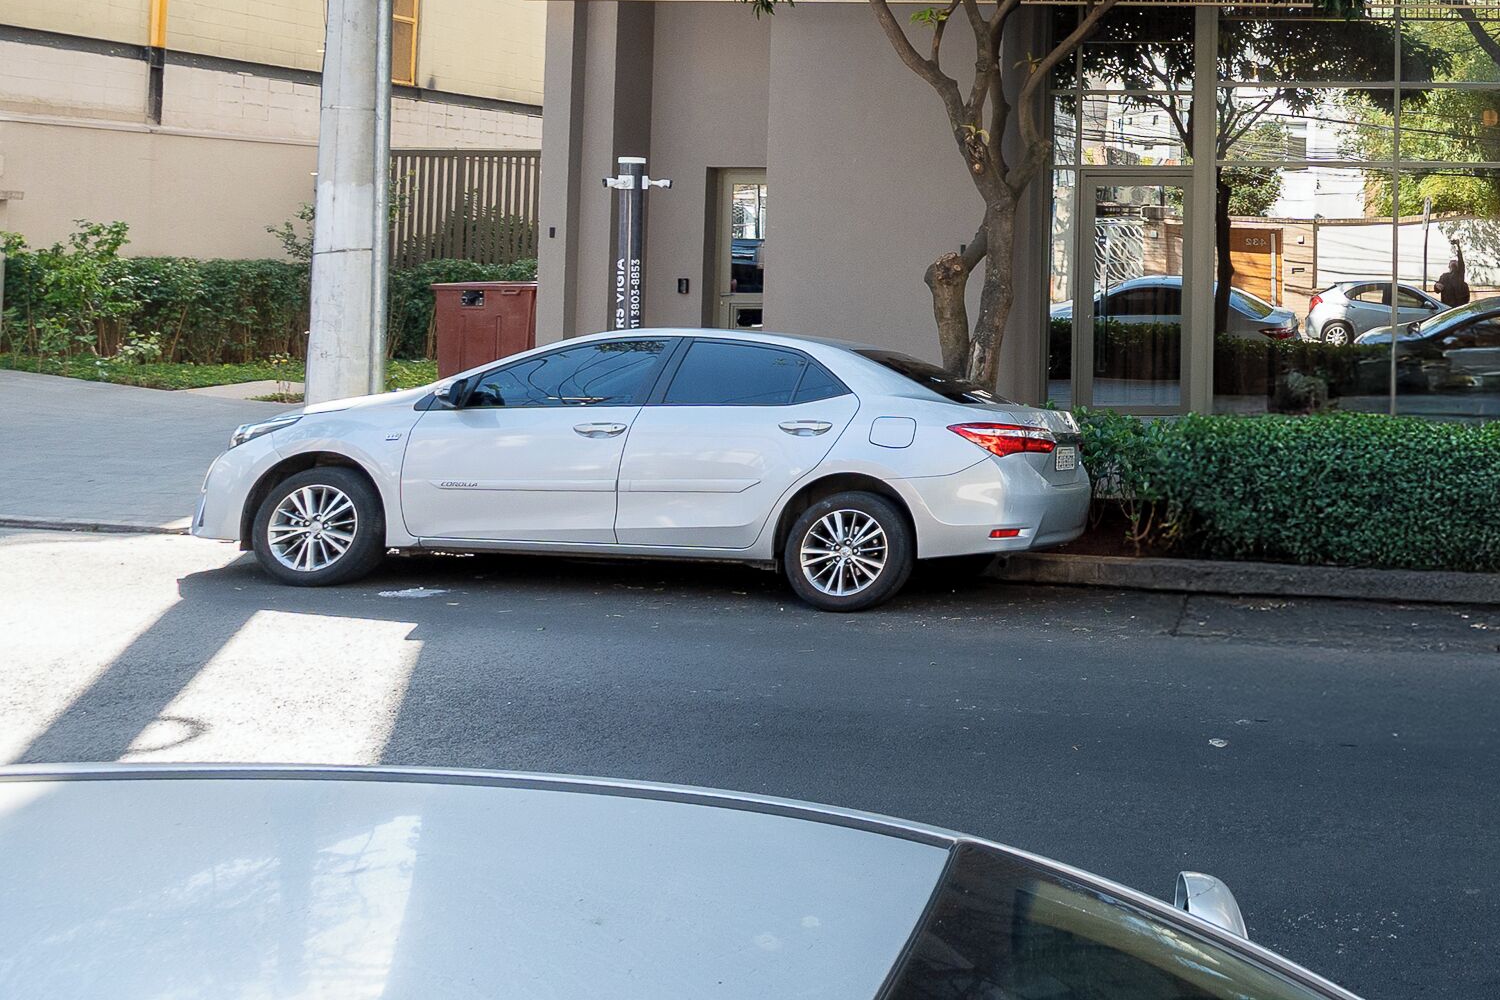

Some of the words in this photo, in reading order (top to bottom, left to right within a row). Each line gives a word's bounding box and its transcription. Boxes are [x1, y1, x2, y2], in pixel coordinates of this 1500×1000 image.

[616, 258, 625, 303] VIGIA
[631, 259, 640, 316] 3803-8853
[616, 308, 625, 328] RS
[631, 319, 640, 329] 11
